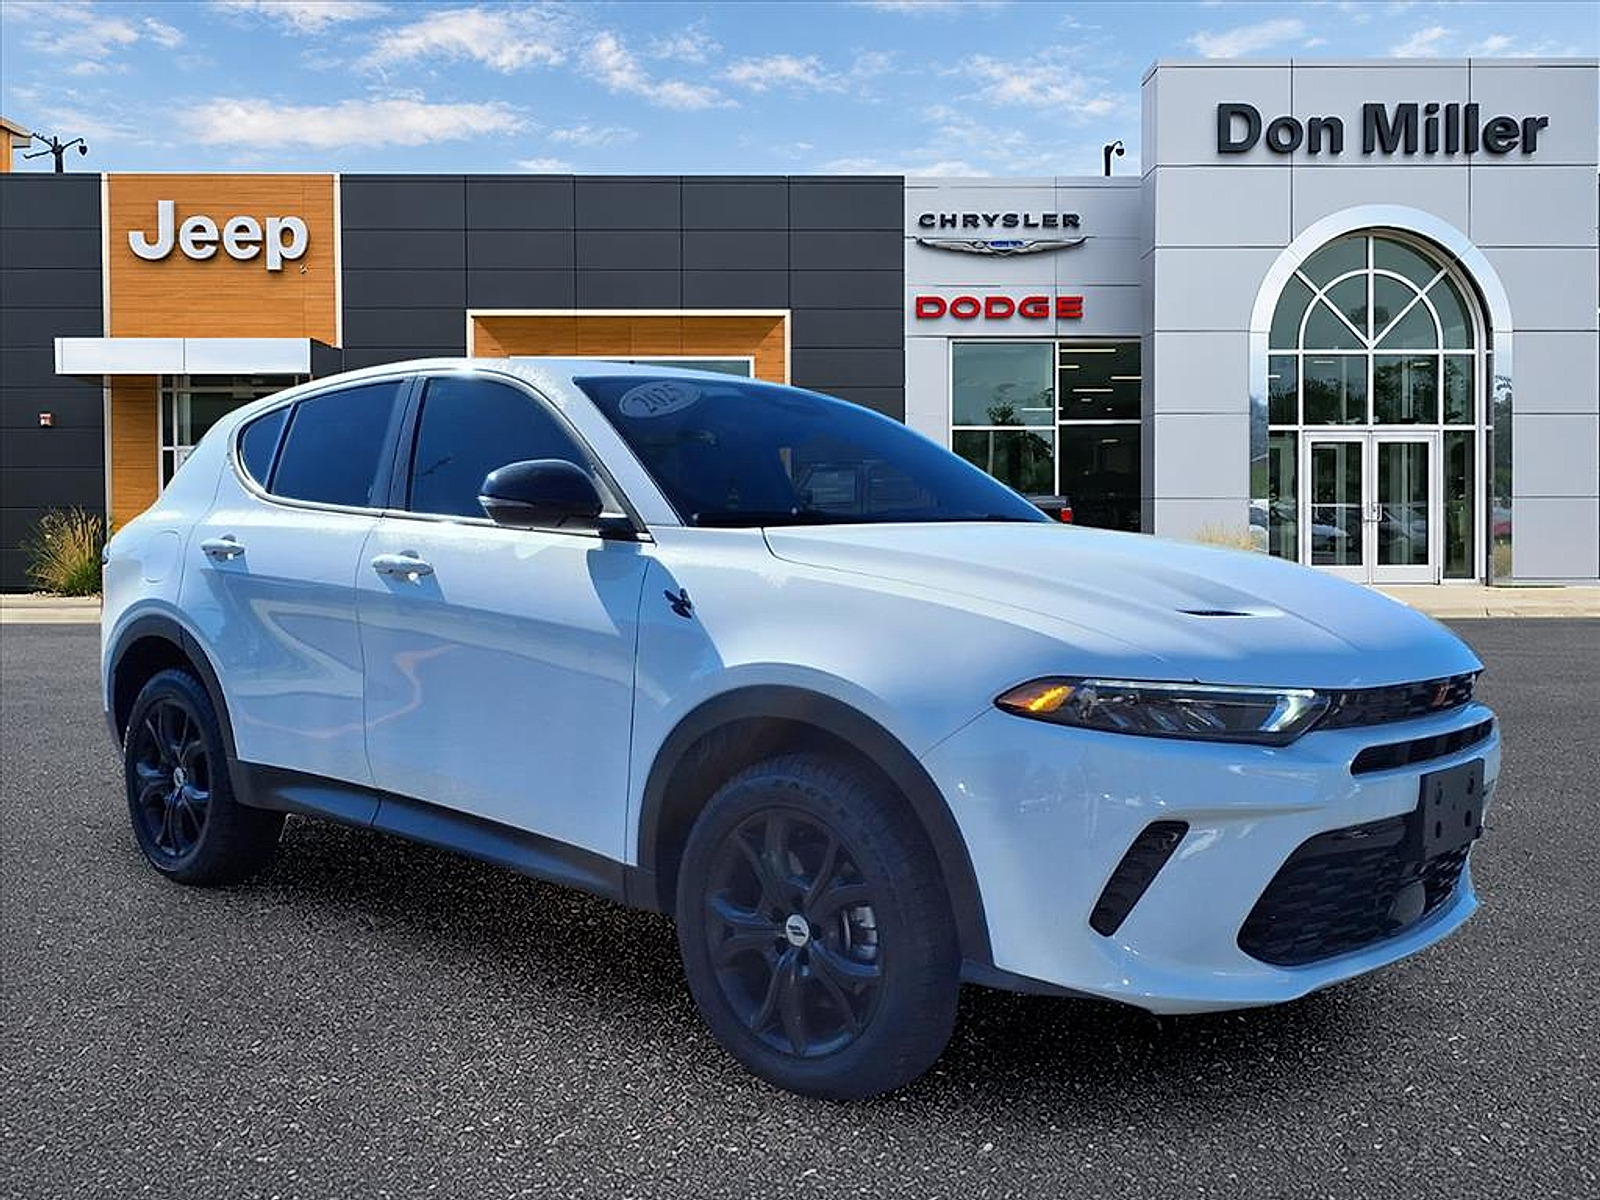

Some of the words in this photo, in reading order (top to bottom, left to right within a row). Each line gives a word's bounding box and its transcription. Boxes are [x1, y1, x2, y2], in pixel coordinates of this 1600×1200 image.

[1216, 103, 1344, 155] Don
[1362, 102, 1549, 156] Miller
[128, 200, 309, 271] Jeep
[918, 212, 1082, 229] CHRYSLER
[915, 296, 1084, 320] DODGE
